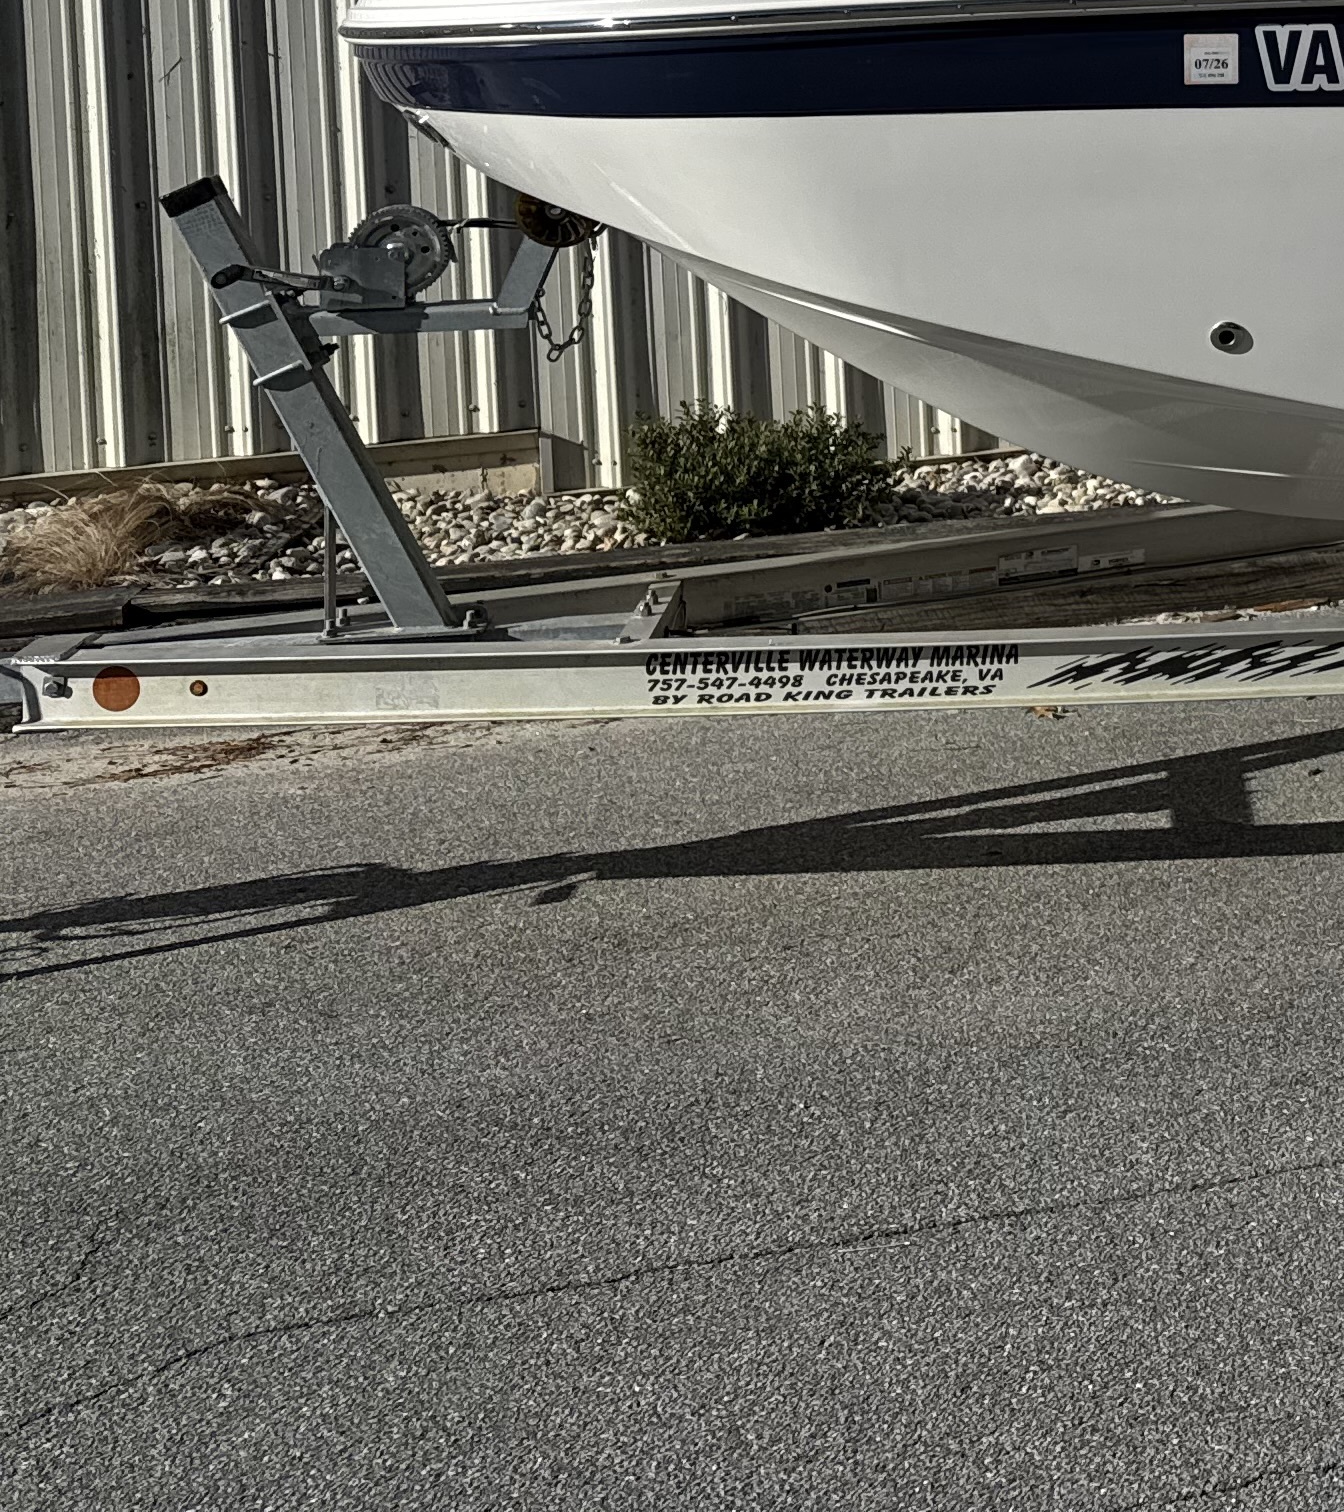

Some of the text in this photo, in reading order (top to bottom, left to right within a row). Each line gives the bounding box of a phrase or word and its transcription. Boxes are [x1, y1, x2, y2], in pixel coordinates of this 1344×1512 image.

[1194, 58, 1229, 69] 07/26
[645, 643, 1019, 676] CENTERVILLE WATERWAY MARINA
[647, 667, 1004, 692] 757-547-4498 CHESAPEAKE, VA
[651, 684, 997, 705] BY ROAD KING TRAILERS
